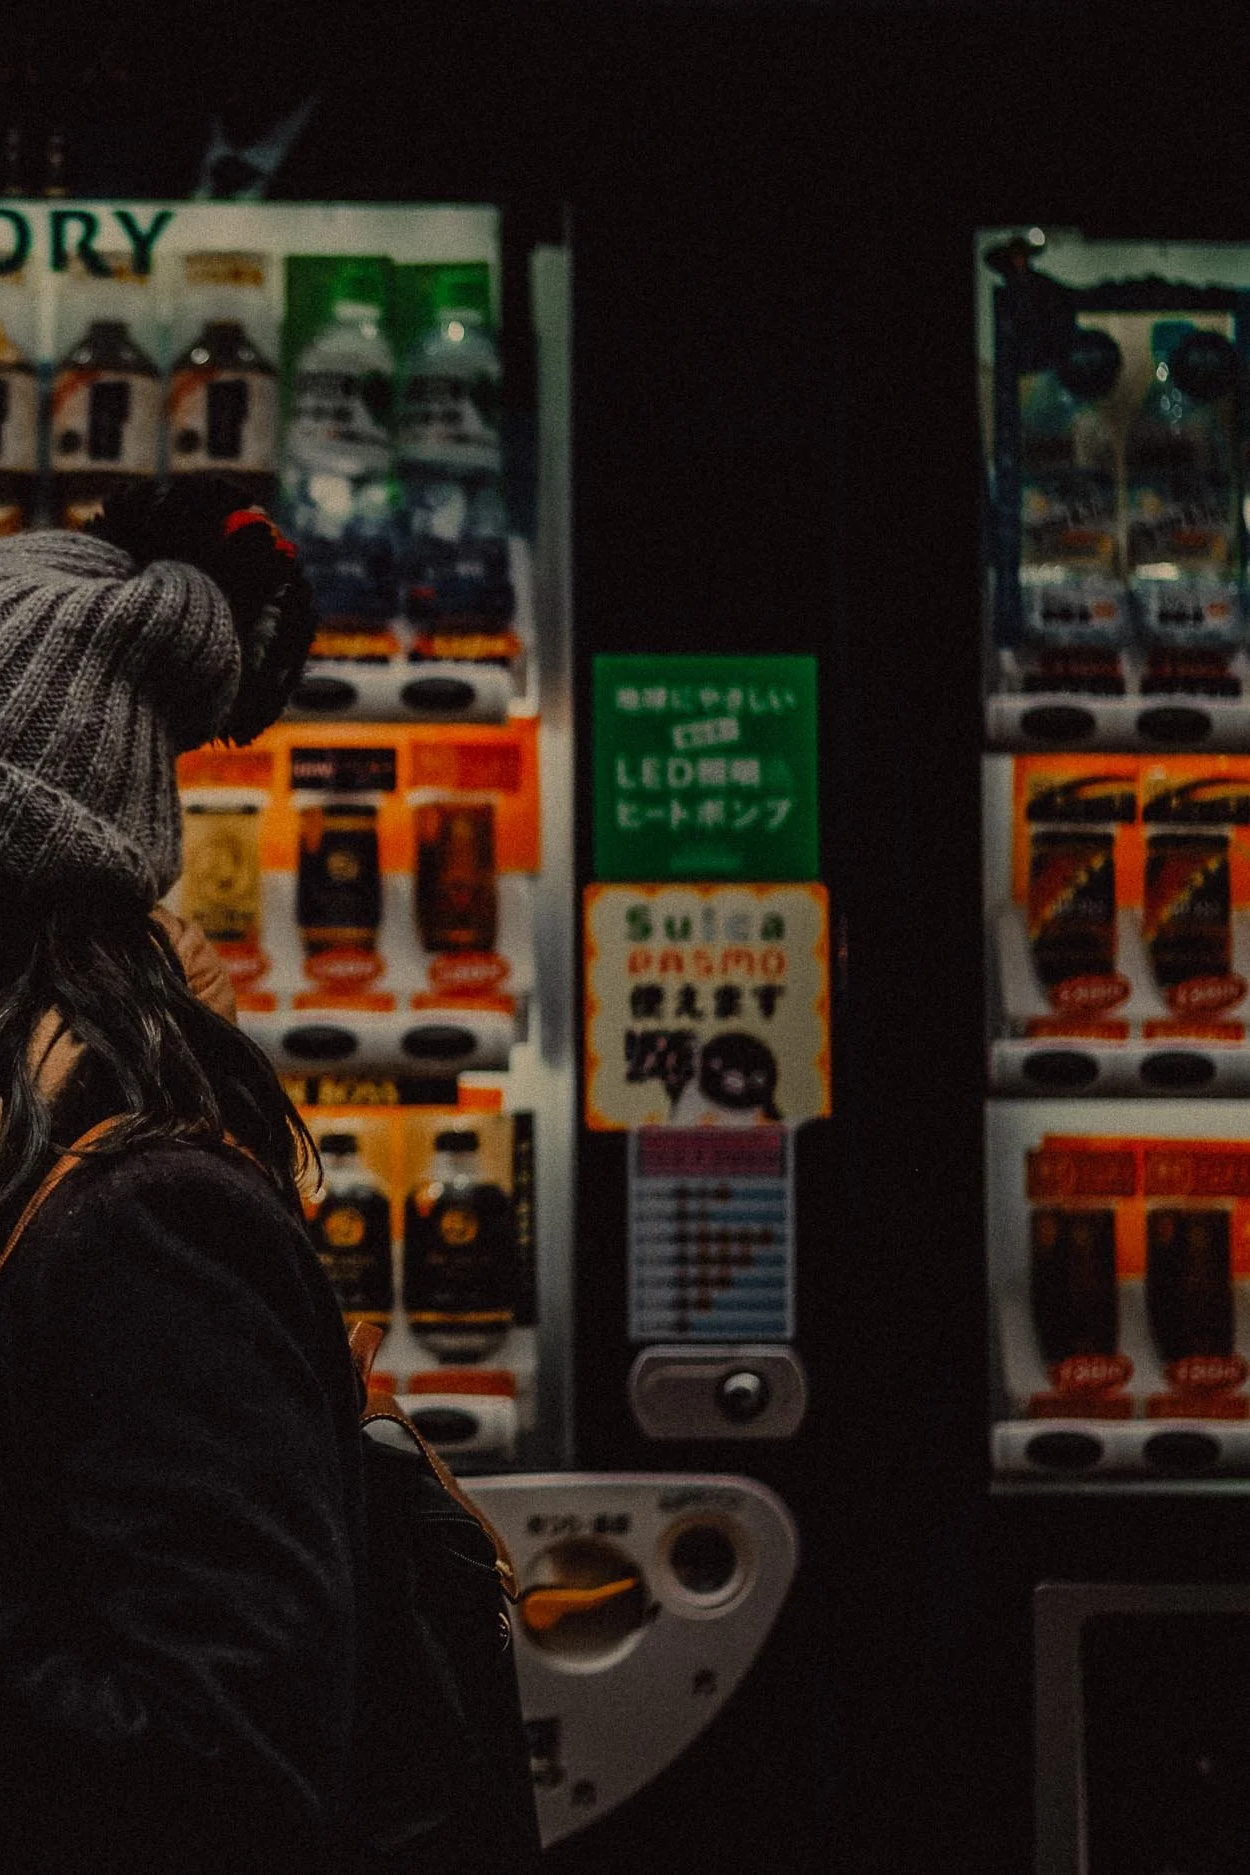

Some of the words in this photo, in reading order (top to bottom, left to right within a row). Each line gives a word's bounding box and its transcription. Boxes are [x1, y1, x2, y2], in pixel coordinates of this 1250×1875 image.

[626, 904, 785, 941] Suica
[627, 946, 786, 977] PASMO
[630, 984, 785, 1018] 使えます
